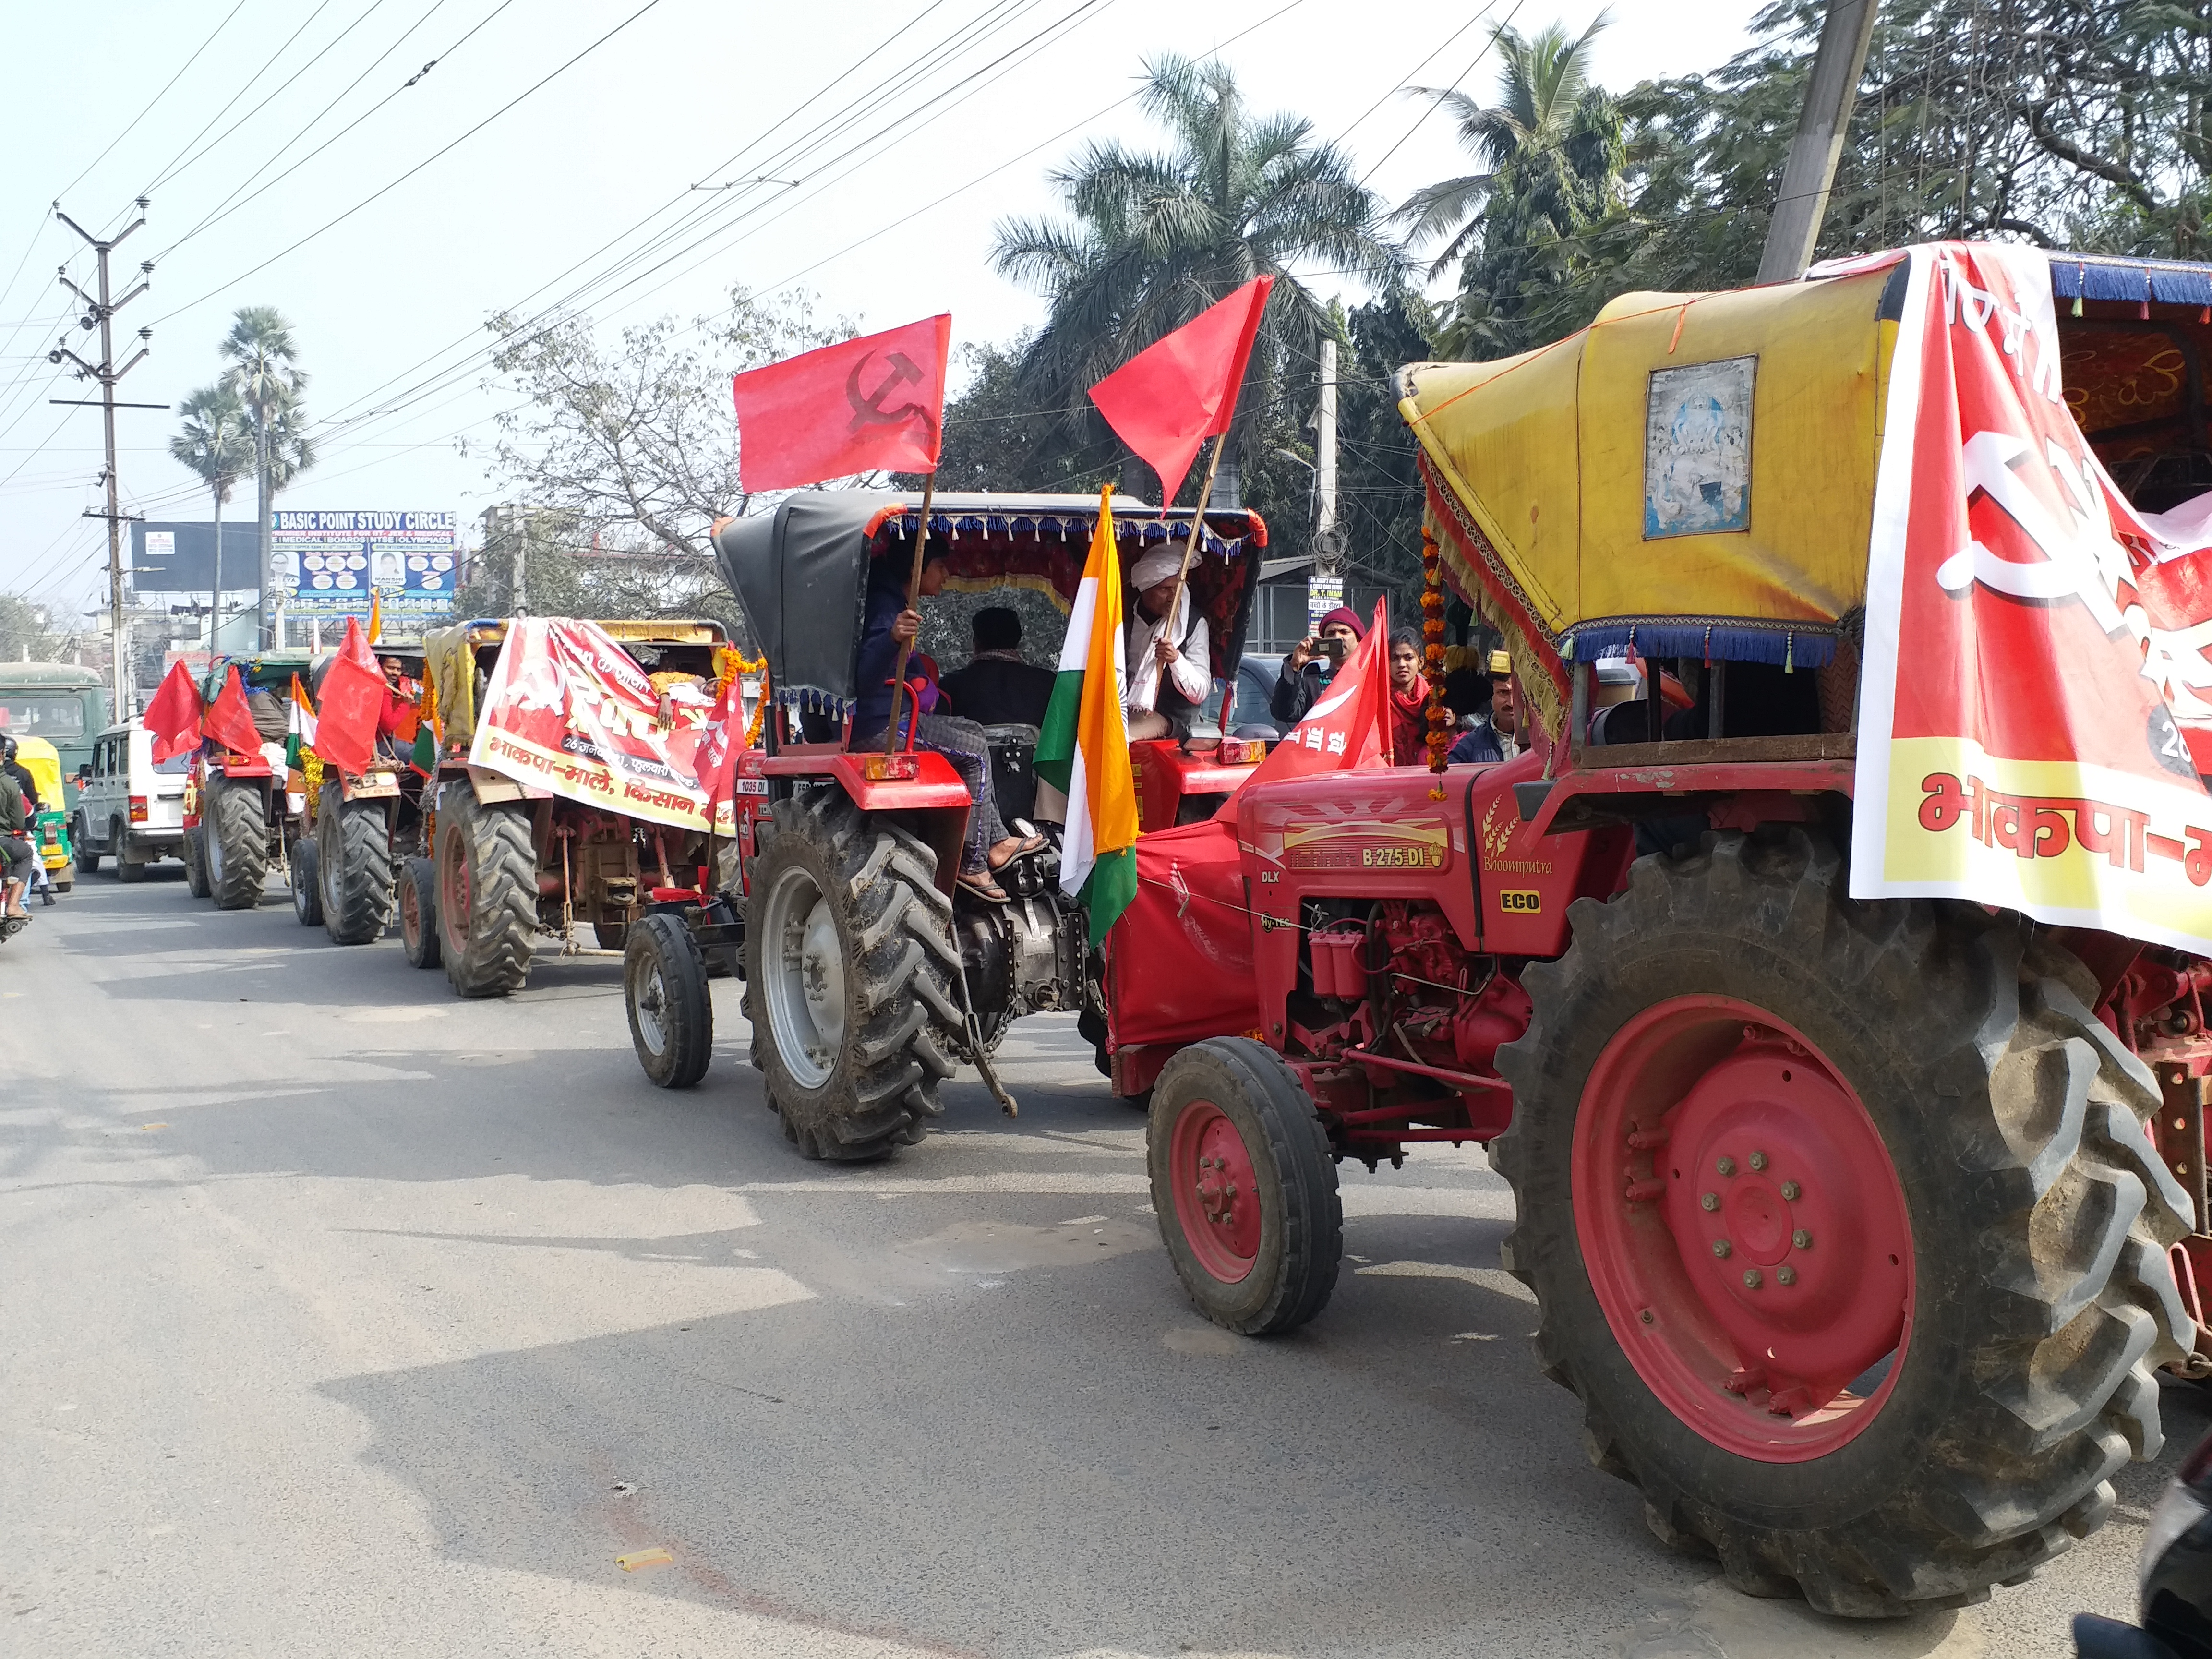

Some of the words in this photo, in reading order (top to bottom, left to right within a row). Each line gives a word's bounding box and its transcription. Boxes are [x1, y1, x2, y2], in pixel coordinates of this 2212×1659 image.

[280, 512, 317, 529] BASIC
[319, 512, 356, 529] POINT
[357, 512, 402, 529] STUDY
[405, 512, 454, 529] CIRCLE
[1322, 601, 1327, 609] के
[564, 737, 577, 749] 26
[489, 737, 615, 795] भाकपा-माले,
[623, 777, 696, 815] किसान
[742, 781, 757, 793] 1035
[757, 781, 765, 793] DI
[1362, 848, 1373, 866] B
[1375, 848, 1404, 866] 275
[1407, 847, 1425, 866] DI
[1484, 856, 1553, 878] Bhoomiputra
[1261, 870, 1280, 883] DLX
[1502, 893, 1539, 910] ECO
